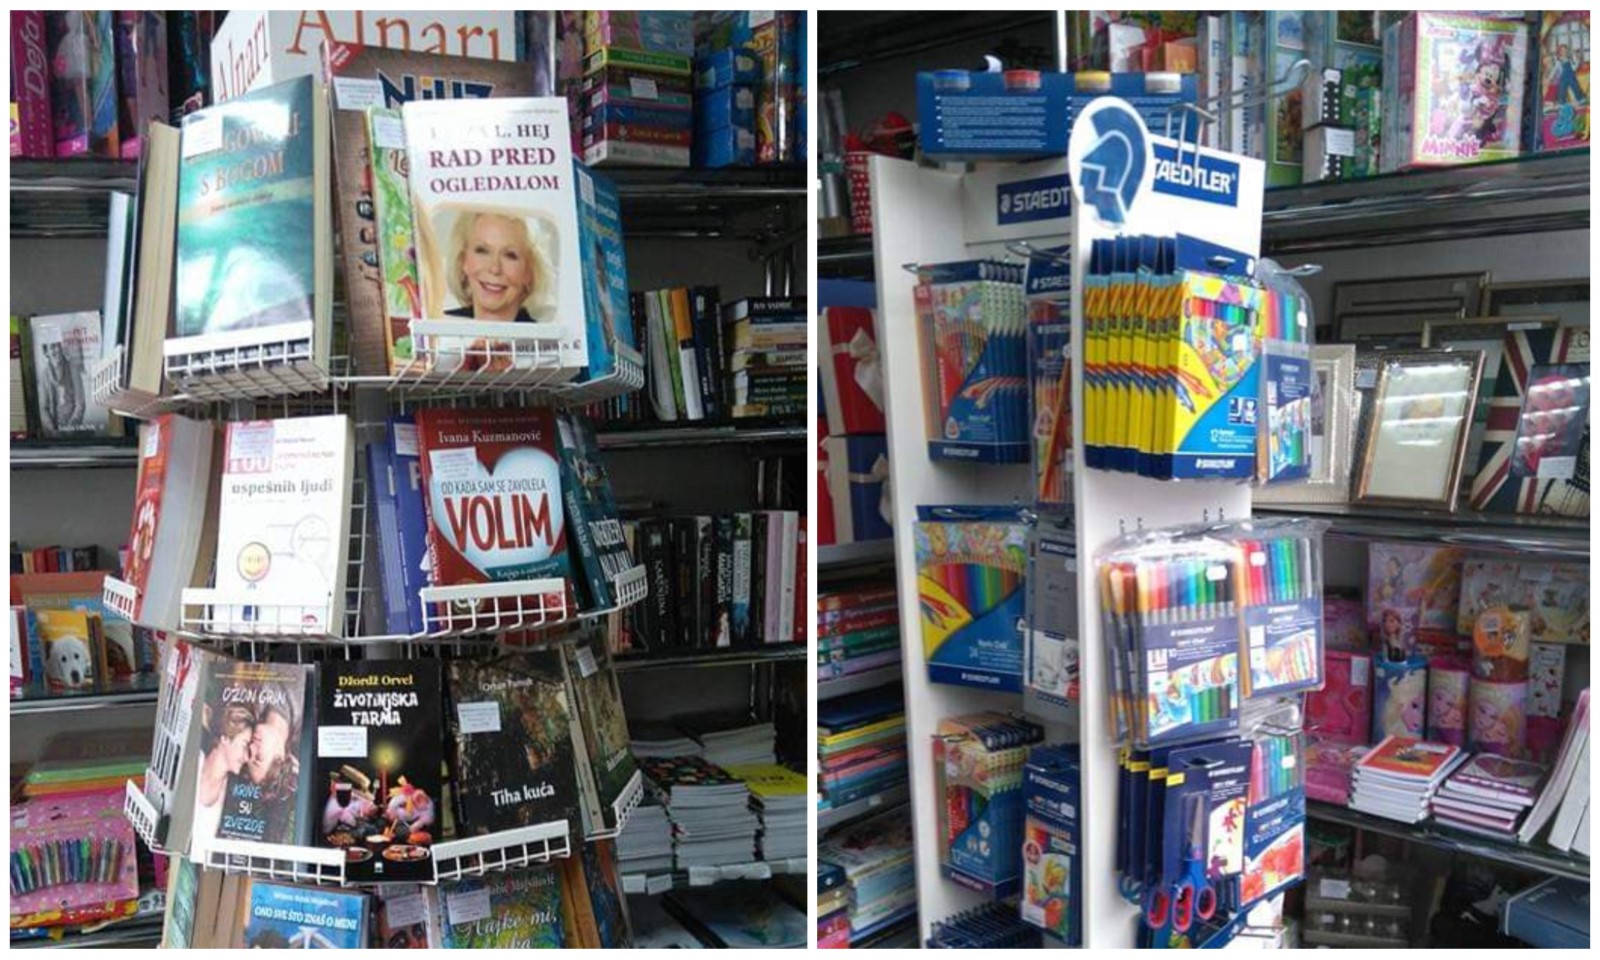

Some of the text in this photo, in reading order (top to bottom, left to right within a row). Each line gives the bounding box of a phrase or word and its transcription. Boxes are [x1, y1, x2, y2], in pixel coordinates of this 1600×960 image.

[516, 124, 551, 140] HEJ
[1422, 135, 1480, 156] MINNIE
[430, 147, 556, 168] RAD PRED
[431, 175, 560, 193] OGLEDALOM
[438, 429, 541, 443] Ivana Kuzmanović
[231, 478, 334, 497] uspešnih ljudi
[441, 478, 547, 495] OD KADA SAM SE ZAVOLELA
[443, 492, 554, 553] VOLIM
[338, 674, 414, 687] Džordž Orvel
[351, 710, 402, 726] FARMA
[490, 781, 554, 807] Tiha kuća
[238, 800, 253, 815] SU
[224, 815, 266, 834] ZVEZDE
[254, 906, 358, 931] ONO SVE ŠTO ZNAŠ O MENI
